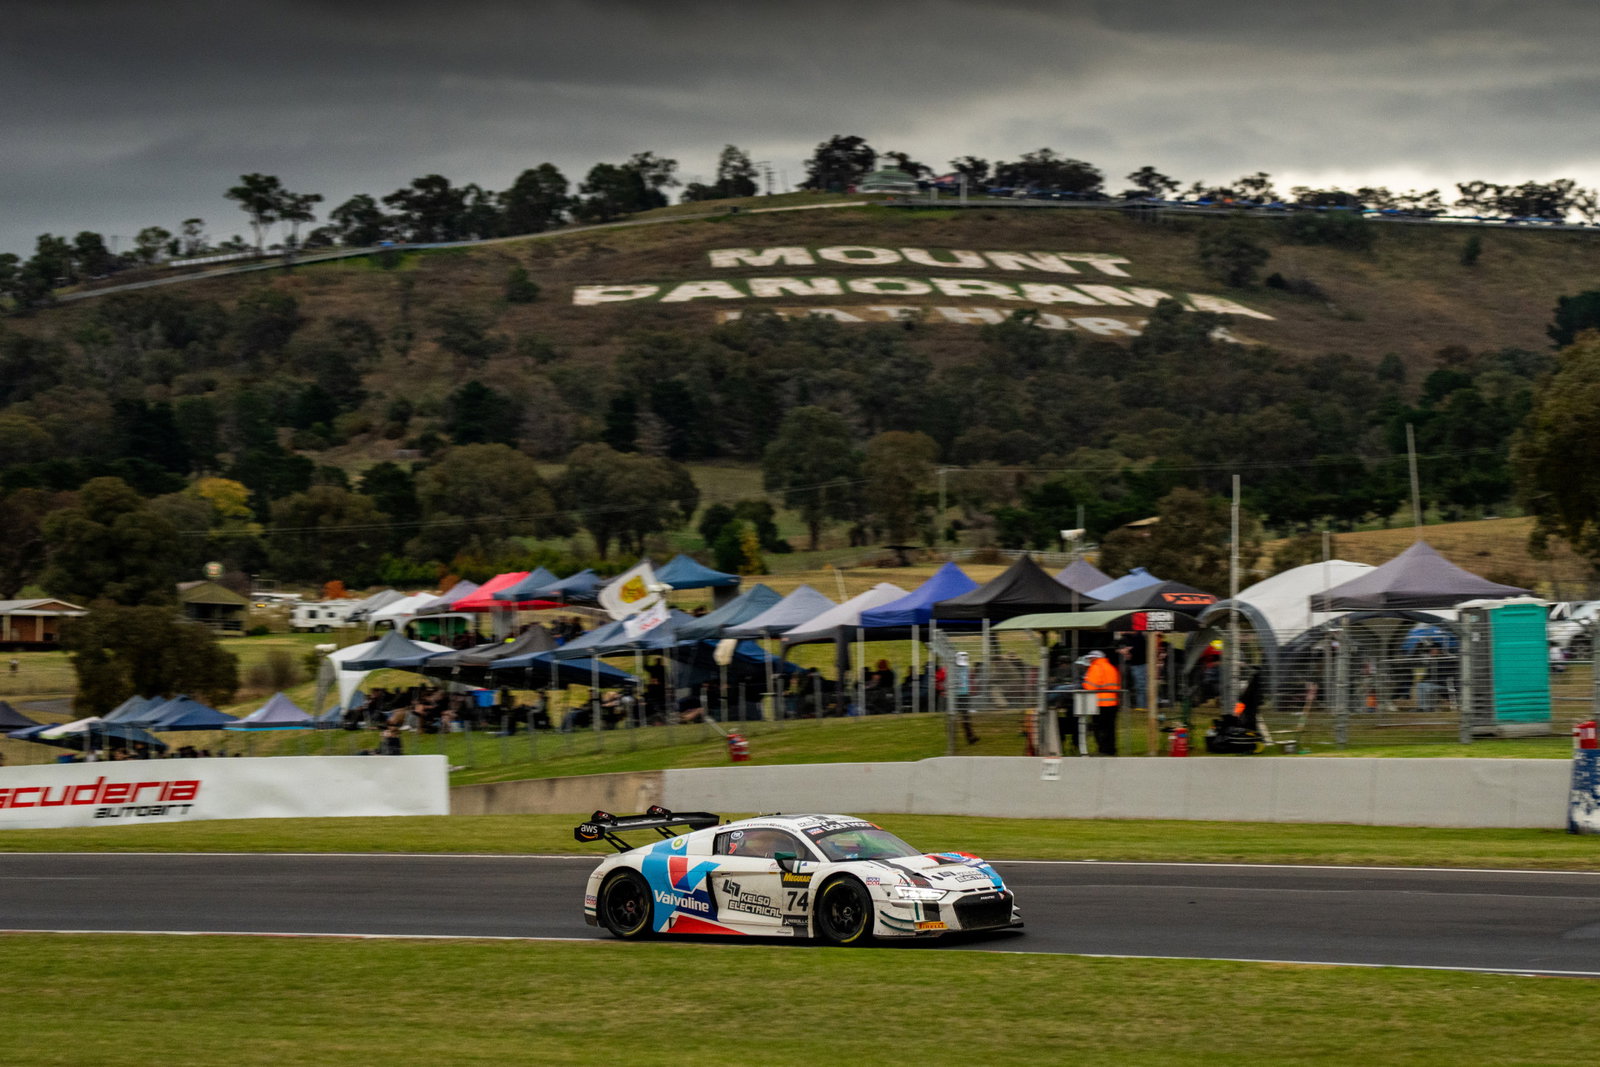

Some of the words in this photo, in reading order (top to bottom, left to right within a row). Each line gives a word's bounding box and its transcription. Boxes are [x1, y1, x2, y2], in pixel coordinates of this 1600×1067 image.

[708, 245, 1132, 277] MOUNT
[572, 276, 1277, 320] PANORAMA
[580, 824, 598, 834] aws
[728, 843, 737, 854] 7
[654, 890, 710, 912] Valvoline
[728, 900, 782, 918] ELECTRICAL
[740, 893, 771, 906] KELSO
[787, 891, 809, 911] 74
